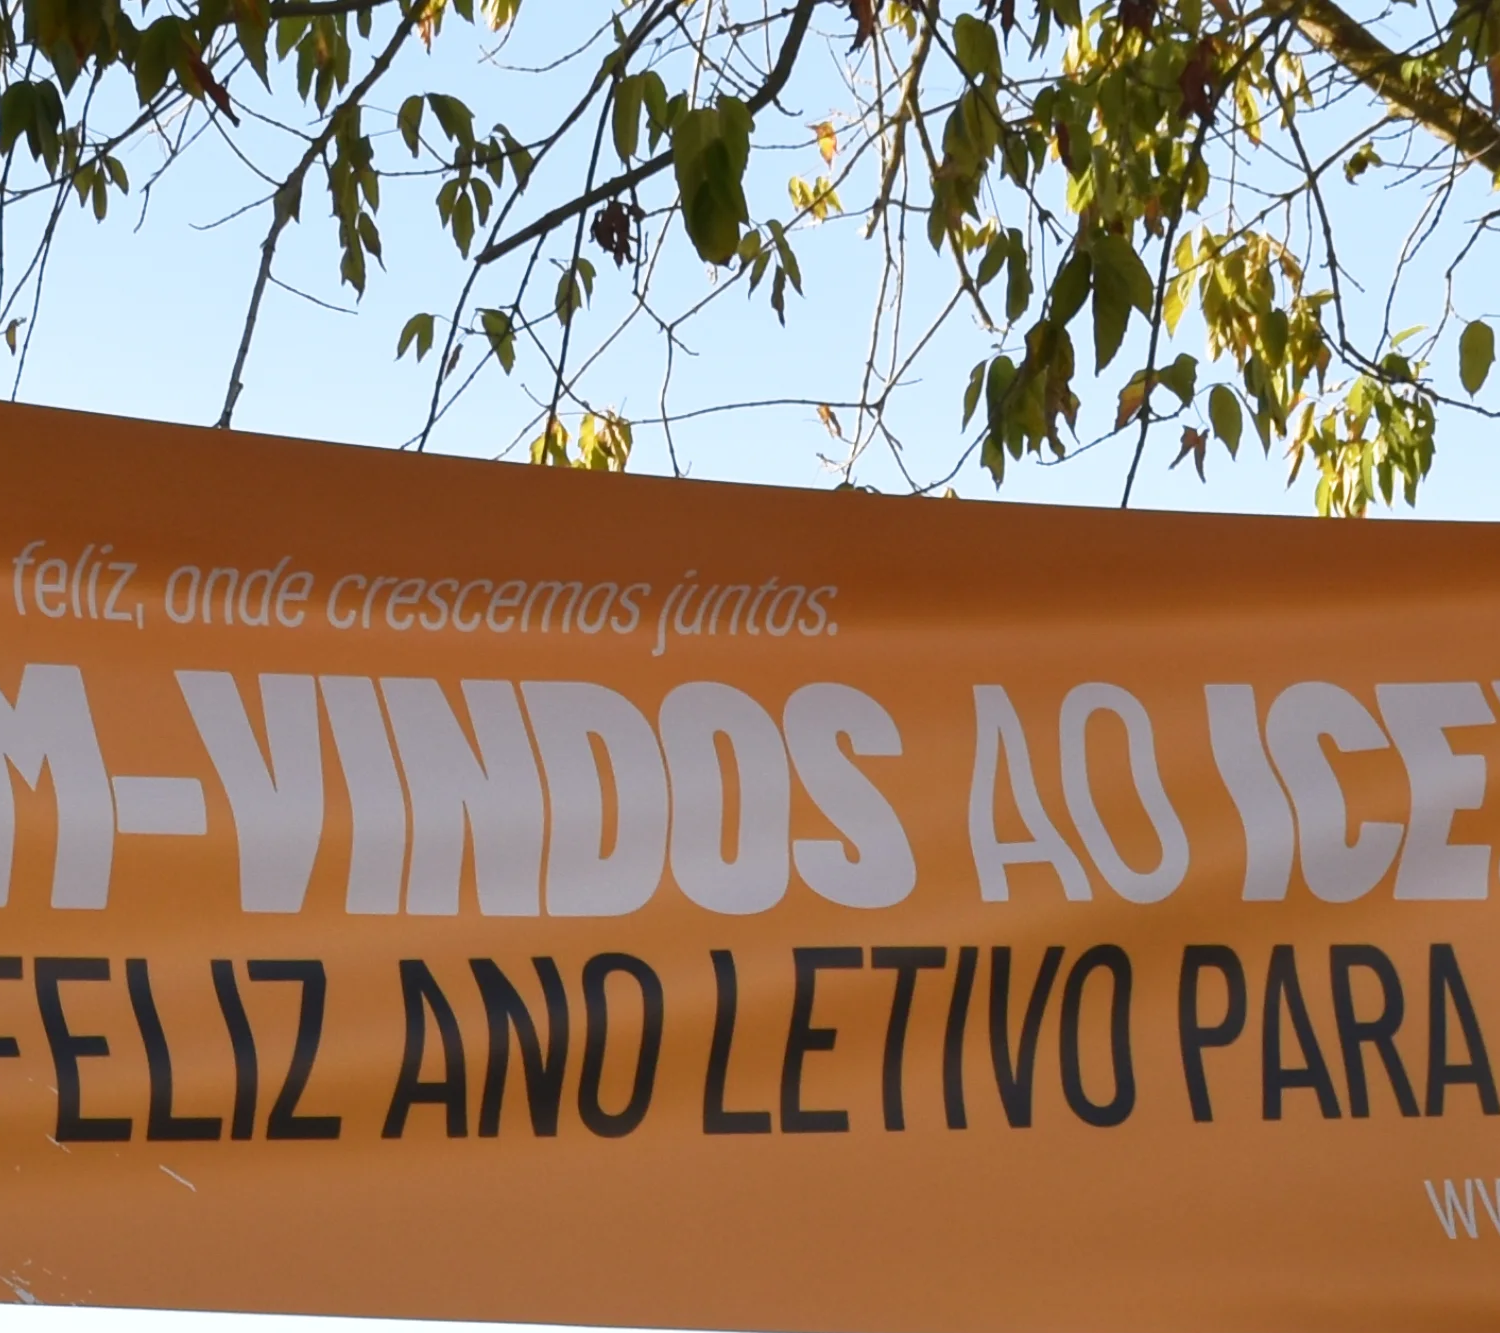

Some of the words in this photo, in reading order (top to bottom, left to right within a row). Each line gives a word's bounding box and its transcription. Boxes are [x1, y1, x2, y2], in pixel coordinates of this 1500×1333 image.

[11, 539, 147, 632] feliz,
[165, 556, 313, 631] onde
[325, 571, 642, 637] crescemos
[650, 568, 842, 658] juntos.
[967, 680, 1191, 905] AO
[380, 950, 665, 1139] ANO
[700, 943, 1136, 1136] LETIVO
